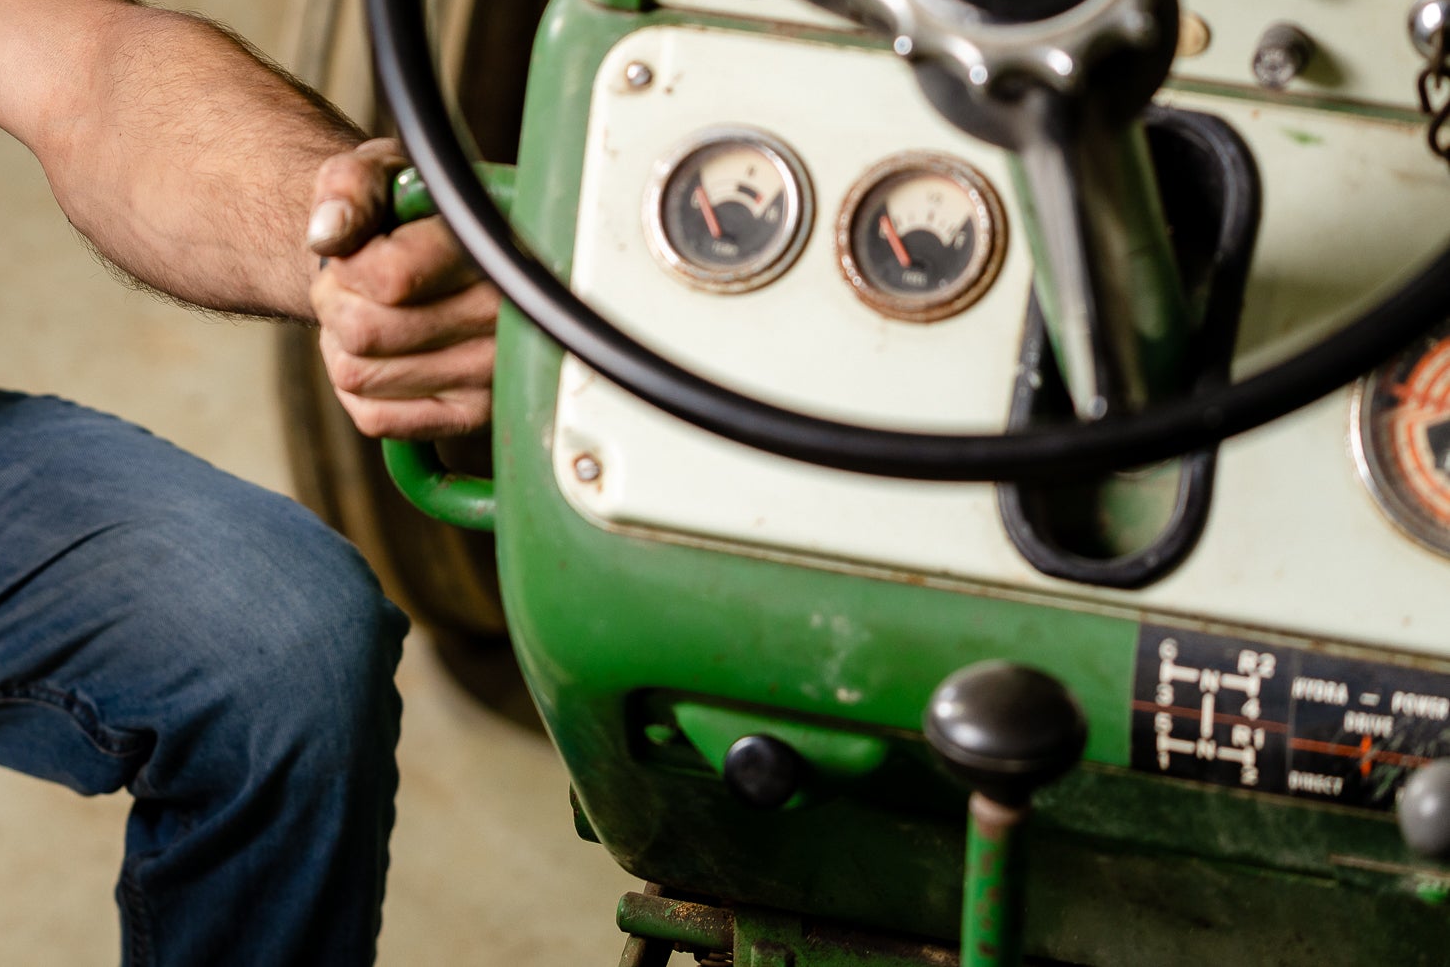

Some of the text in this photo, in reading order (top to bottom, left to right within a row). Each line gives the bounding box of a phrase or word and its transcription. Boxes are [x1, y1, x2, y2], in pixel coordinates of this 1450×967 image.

[1237, 649, 1277, 679] R2
[1155, 682, 1174, 706] 3
[1200, 668, 1221, 694] N
[1241, 697, 1261, 720] 4
[1292, 676, 1348, 706] HYDRA
[1391, 691, 1450, 720] POWER
[1344, 710, 1394, 738] DRIVE
[1197, 737, 1217, 760] N
[1288, 770, 1343, 796] DIRECT
